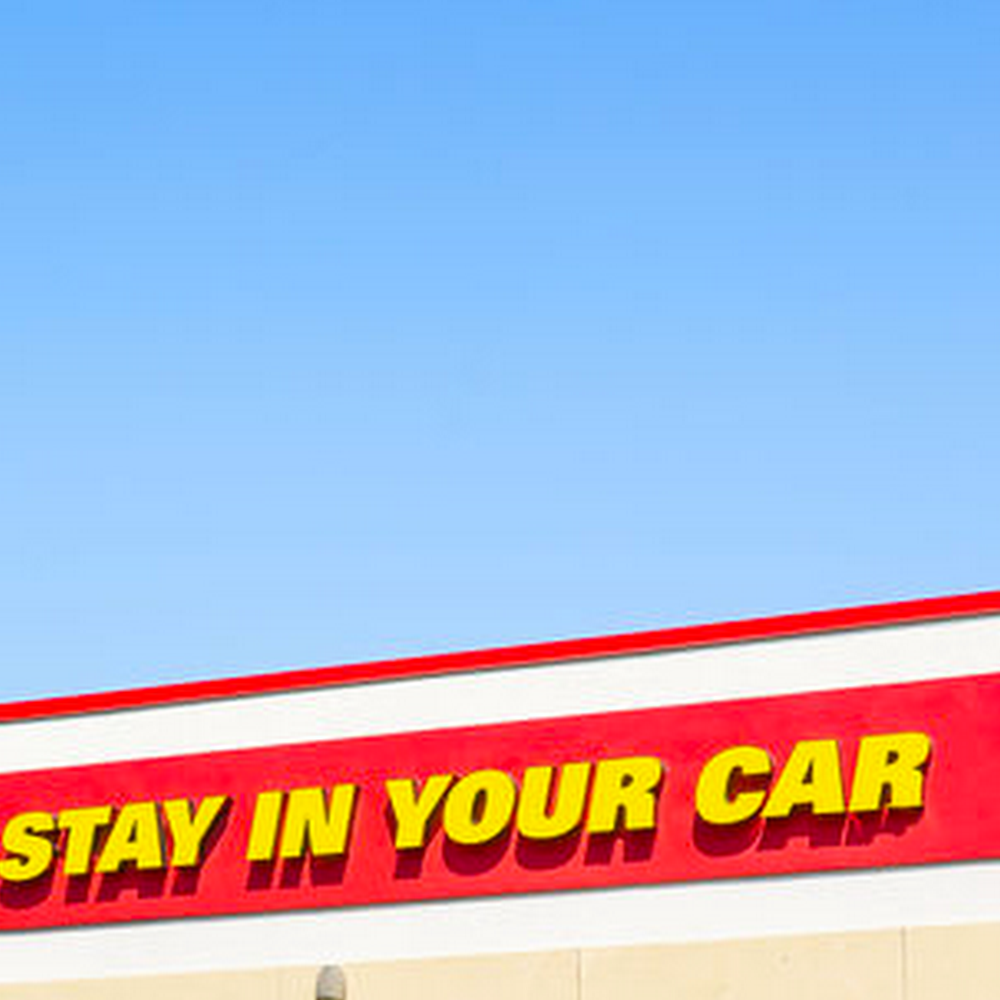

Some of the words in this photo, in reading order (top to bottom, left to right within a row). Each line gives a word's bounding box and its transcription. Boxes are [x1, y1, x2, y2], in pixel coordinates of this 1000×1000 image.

[246, 784, 356, 861] IN
[385, 757, 664, 849] YOUR
[695, 733, 932, 825] CAR
